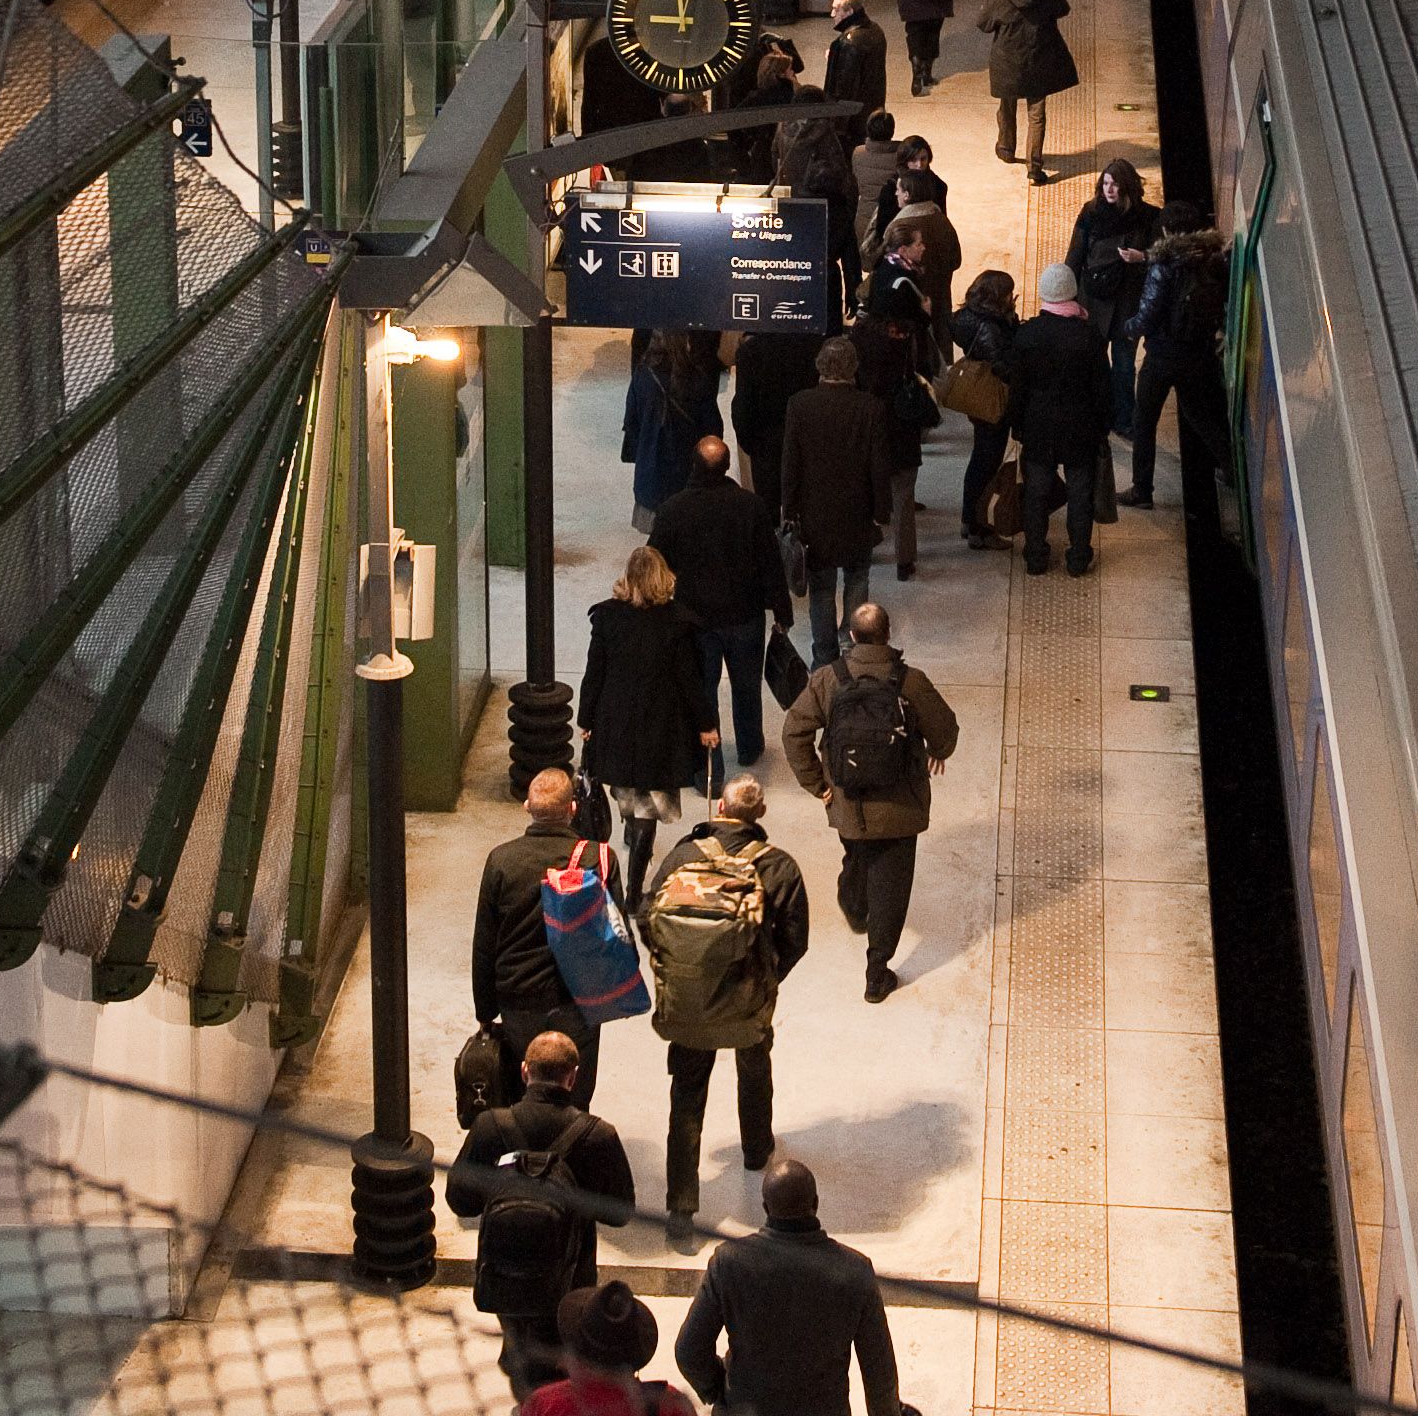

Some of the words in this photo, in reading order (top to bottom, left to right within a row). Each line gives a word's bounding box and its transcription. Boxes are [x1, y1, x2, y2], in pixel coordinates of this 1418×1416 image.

[187, 112, 205, 125] 45
[731, 212, 784, 229] Sortie
[731, 230, 750, 240] Exit
[758, 230, 793, 242] Uitgang
[730, 256, 812, 271] Correspondance
[731, 271, 761, 281] Transfer
[765, 272, 812, 282] Overstappen
[741, 304, 751, 317] E
[770, 313, 813, 321] eurostar
